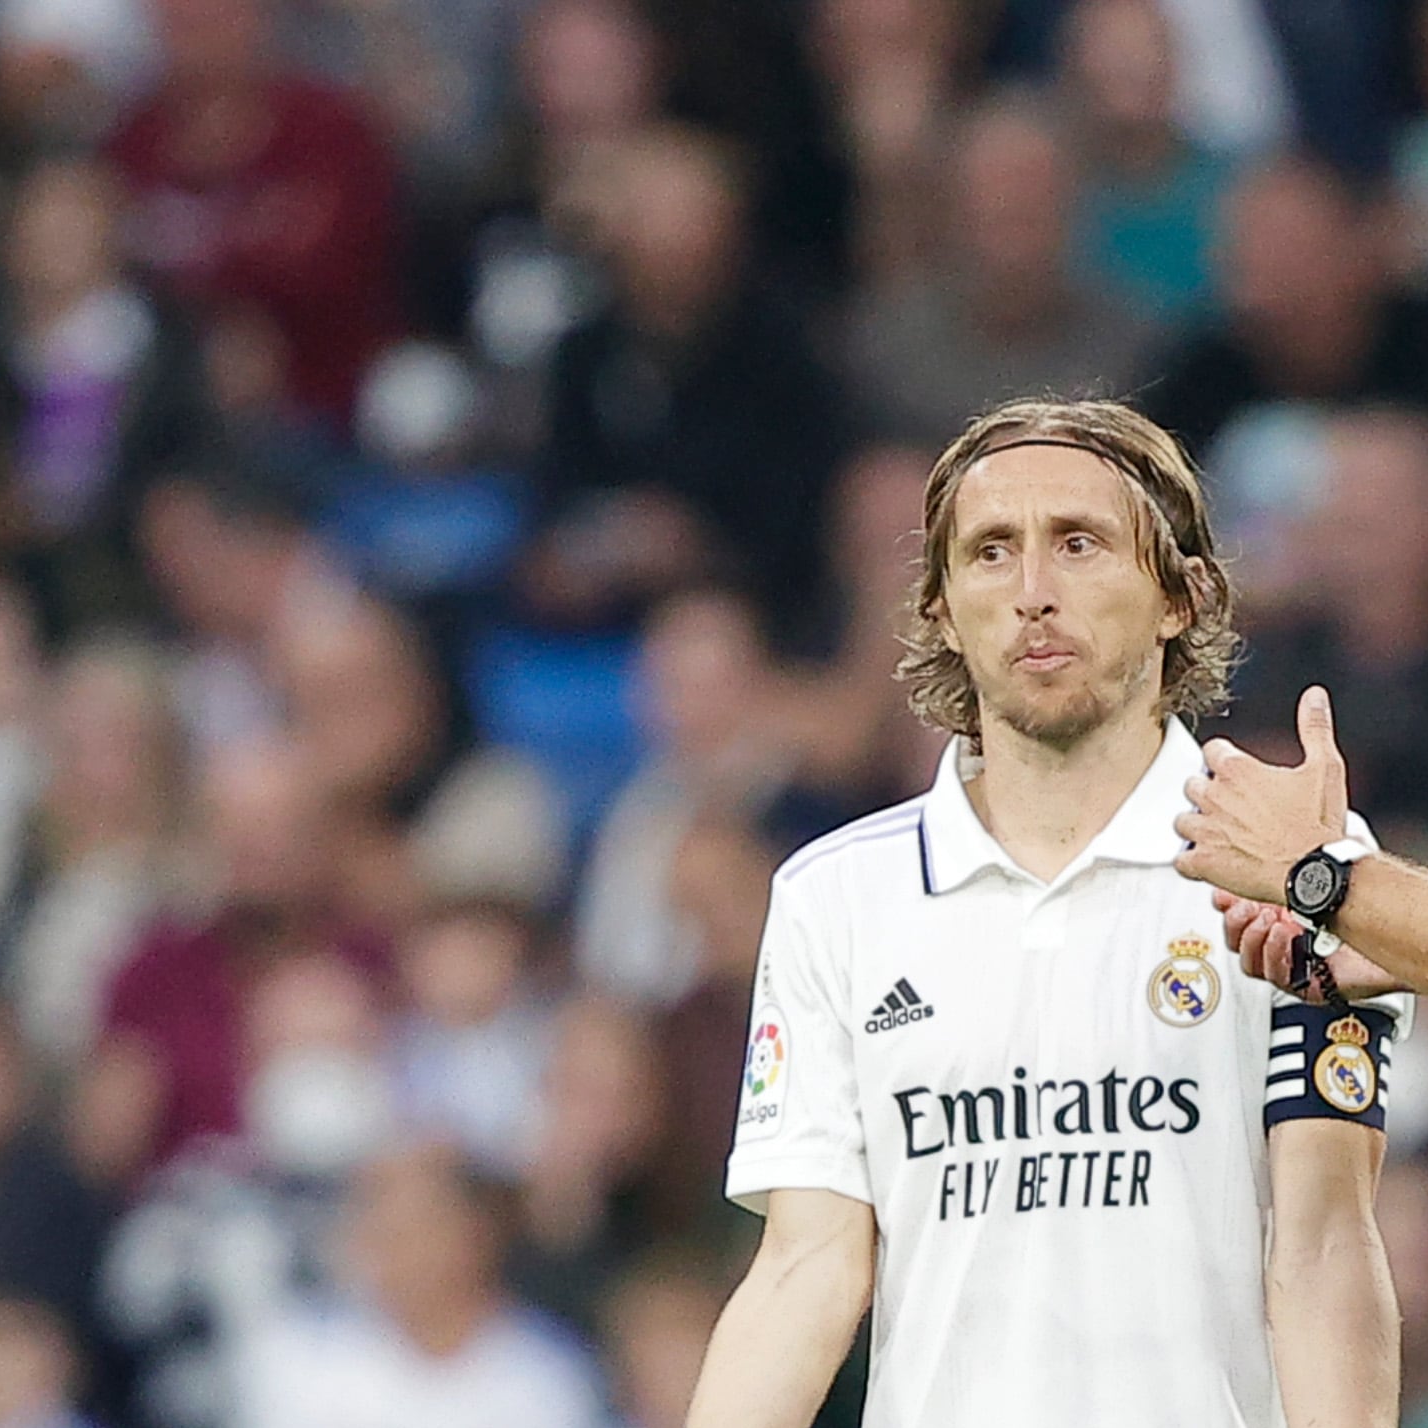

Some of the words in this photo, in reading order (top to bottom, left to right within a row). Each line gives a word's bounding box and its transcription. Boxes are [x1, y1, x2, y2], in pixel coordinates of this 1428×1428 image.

[864, 1003, 935, 1034] adidas
[893, 1066, 1202, 1161] Emirates
[939, 1159, 999, 1221] FLY
[1016, 1149, 1152, 1213] BETTER
